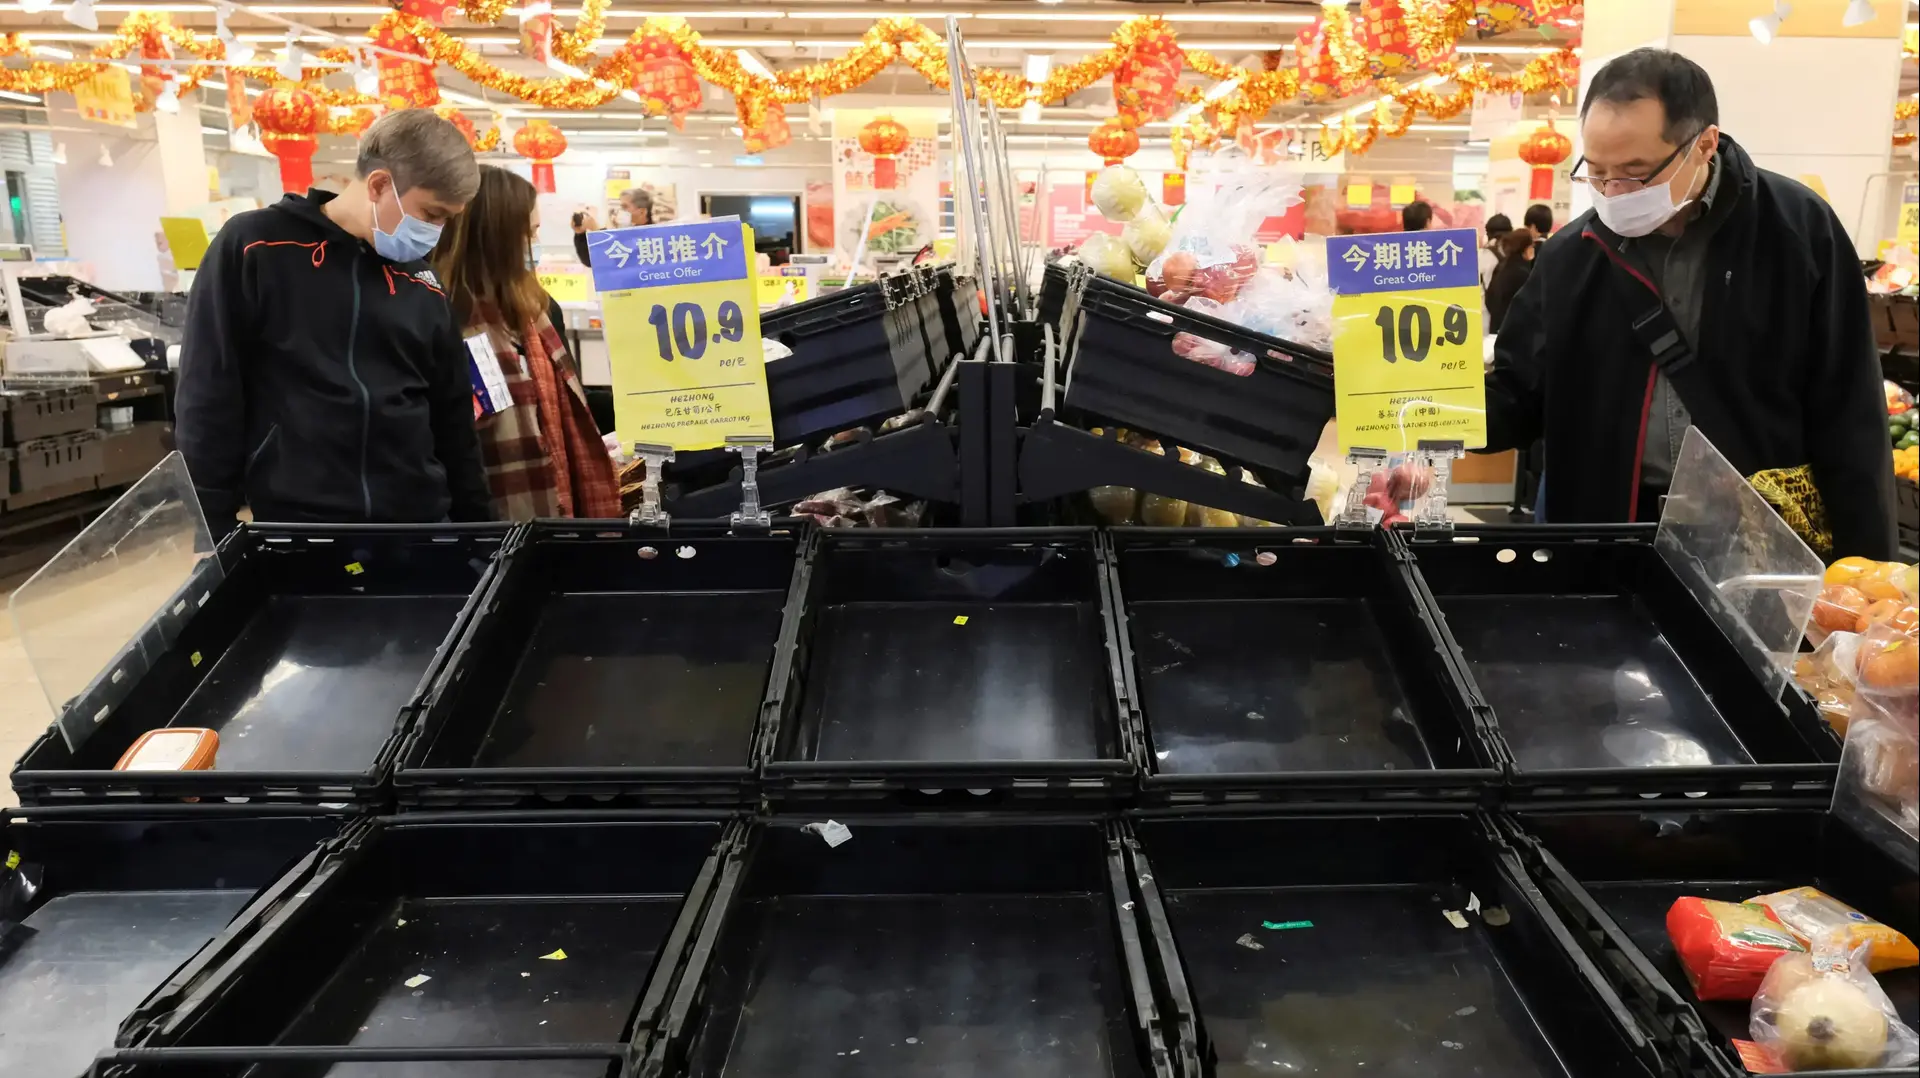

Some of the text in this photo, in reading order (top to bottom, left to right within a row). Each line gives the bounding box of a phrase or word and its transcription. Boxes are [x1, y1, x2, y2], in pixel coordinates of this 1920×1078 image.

[604, 232, 729, 269] 今期推介
[1341, 239, 1464, 272] 今期推介
[639, 266, 703, 281] Great Offer
[1373, 272, 1437, 285] Great Offer
[648, 300, 744, 362] 10.9
[1375, 304, 1468, 364] 10.9
[670, 393, 715, 404] HEZHONG
[1389, 396, 1433, 405] HEZHONG
[641, 420, 675, 430] HEZHONG
